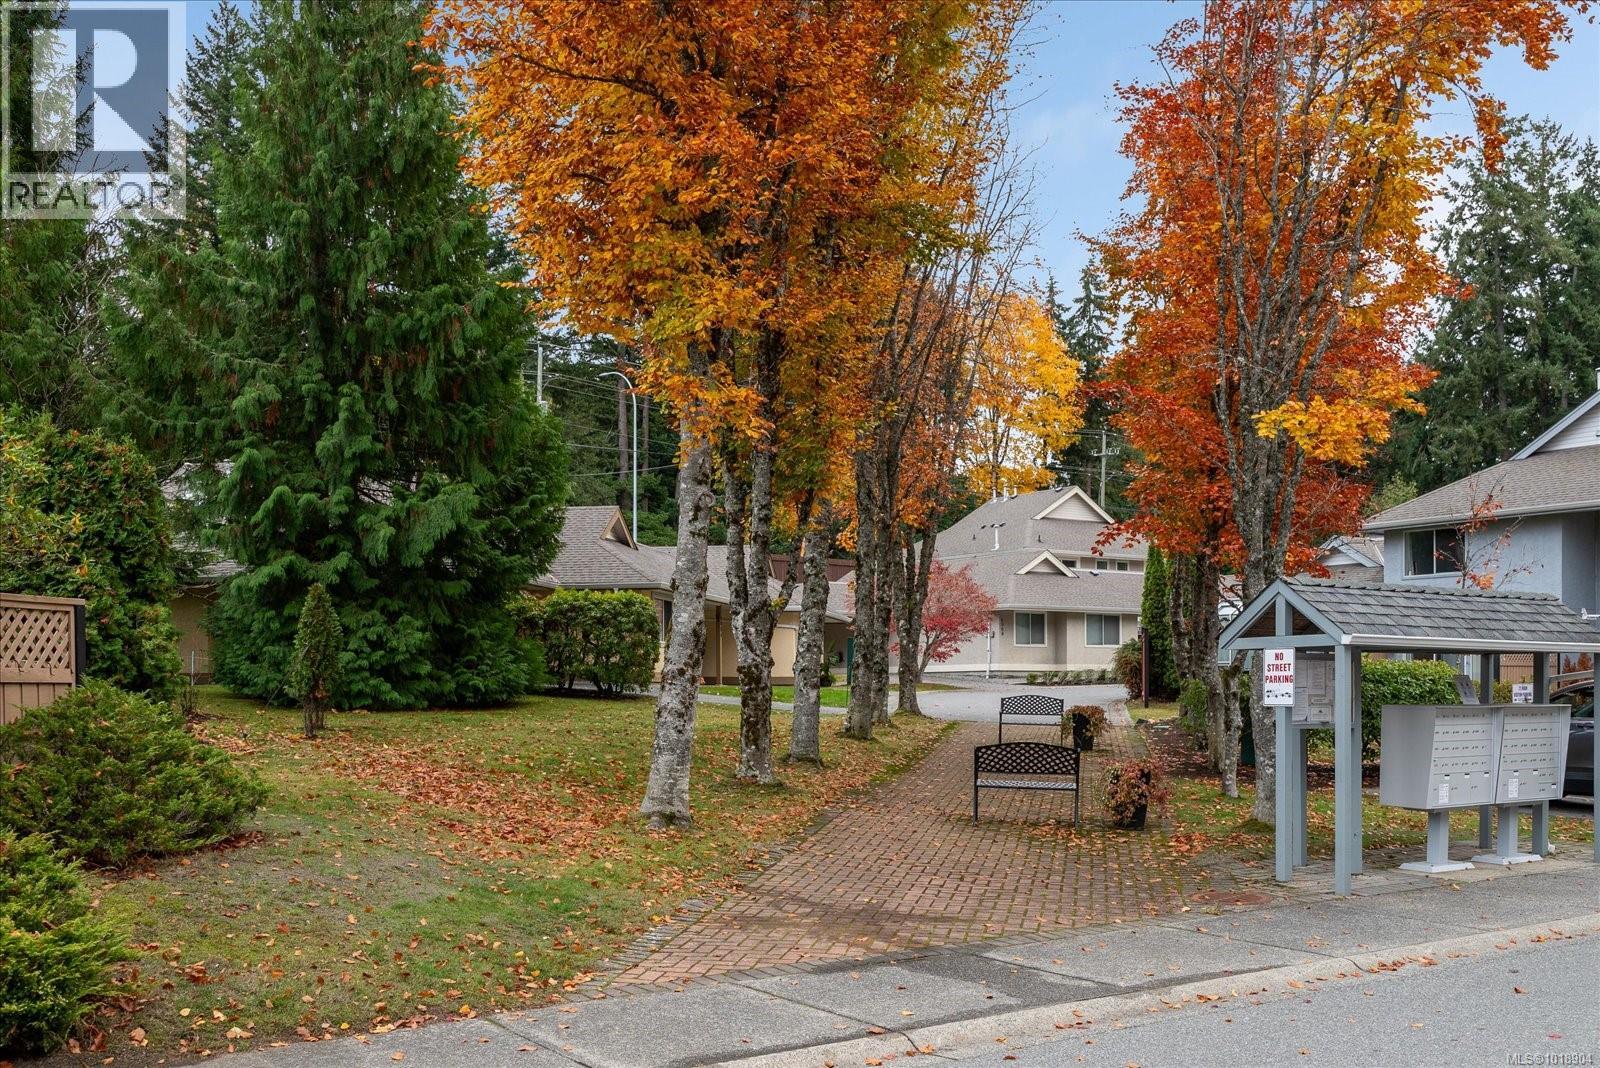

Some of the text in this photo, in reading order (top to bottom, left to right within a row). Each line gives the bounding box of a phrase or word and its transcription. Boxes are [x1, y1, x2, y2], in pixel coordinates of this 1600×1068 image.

[1274, 652, 1284, 661] NO
[1266, 663, 1292, 672] STREET
[1265, 674, 1294, 684] PARKING
